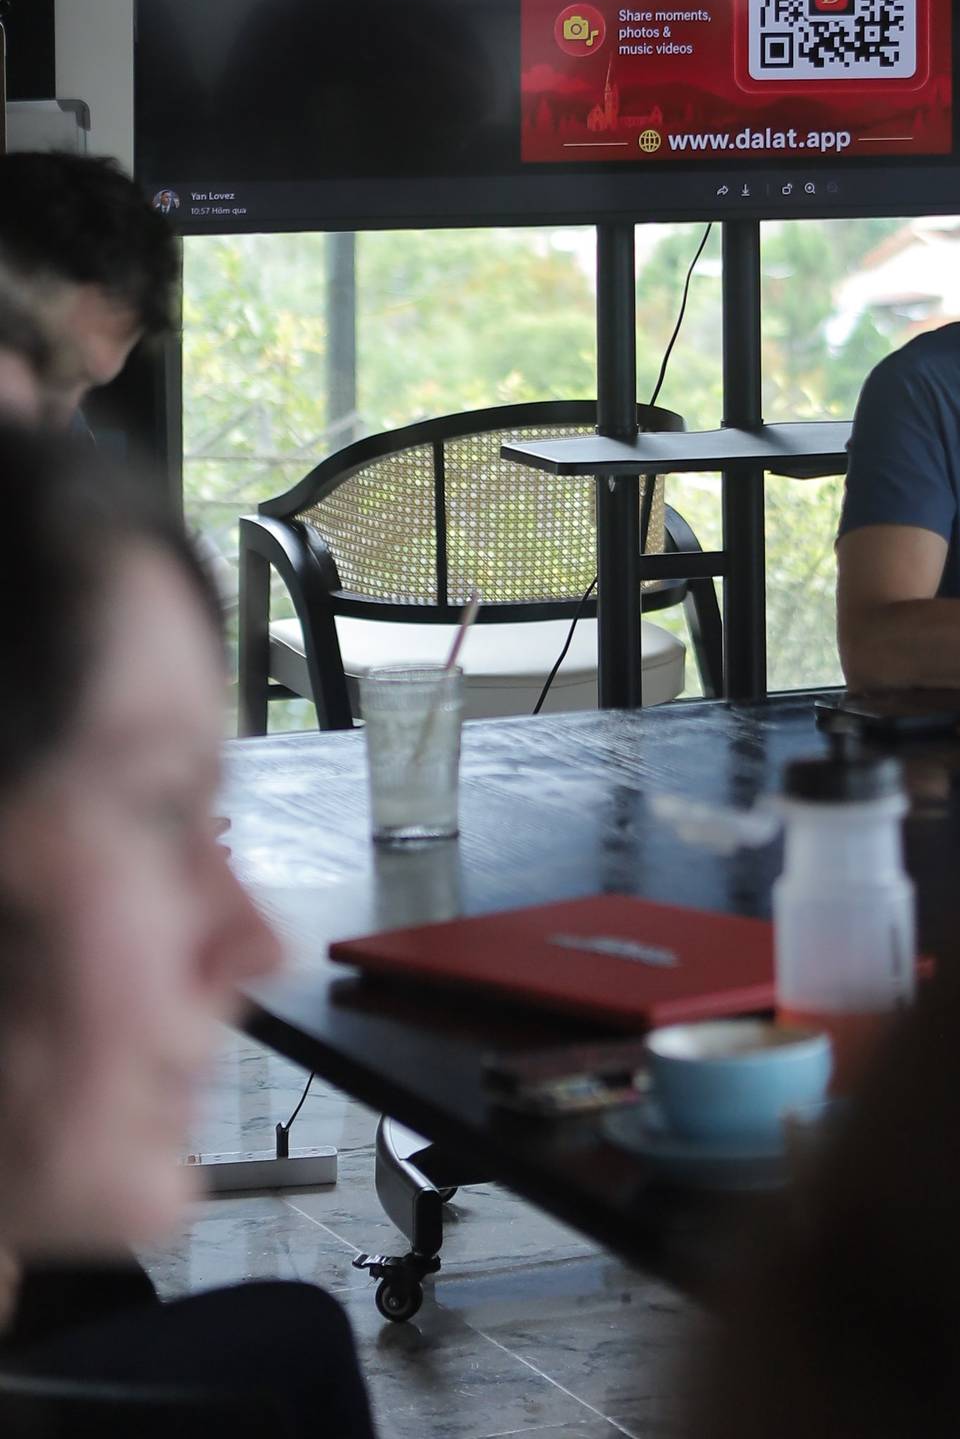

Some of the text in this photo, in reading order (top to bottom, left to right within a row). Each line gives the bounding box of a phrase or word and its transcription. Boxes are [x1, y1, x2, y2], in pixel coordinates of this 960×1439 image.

[618, 9, 711, 24] Share moments,
[618, 26, 672, 41] photos &
[618, 42, 693, 56] music videos
[668, 128, 851, 152] www.dalat.app
[191, 192, 235, 200] Yan Lovez
